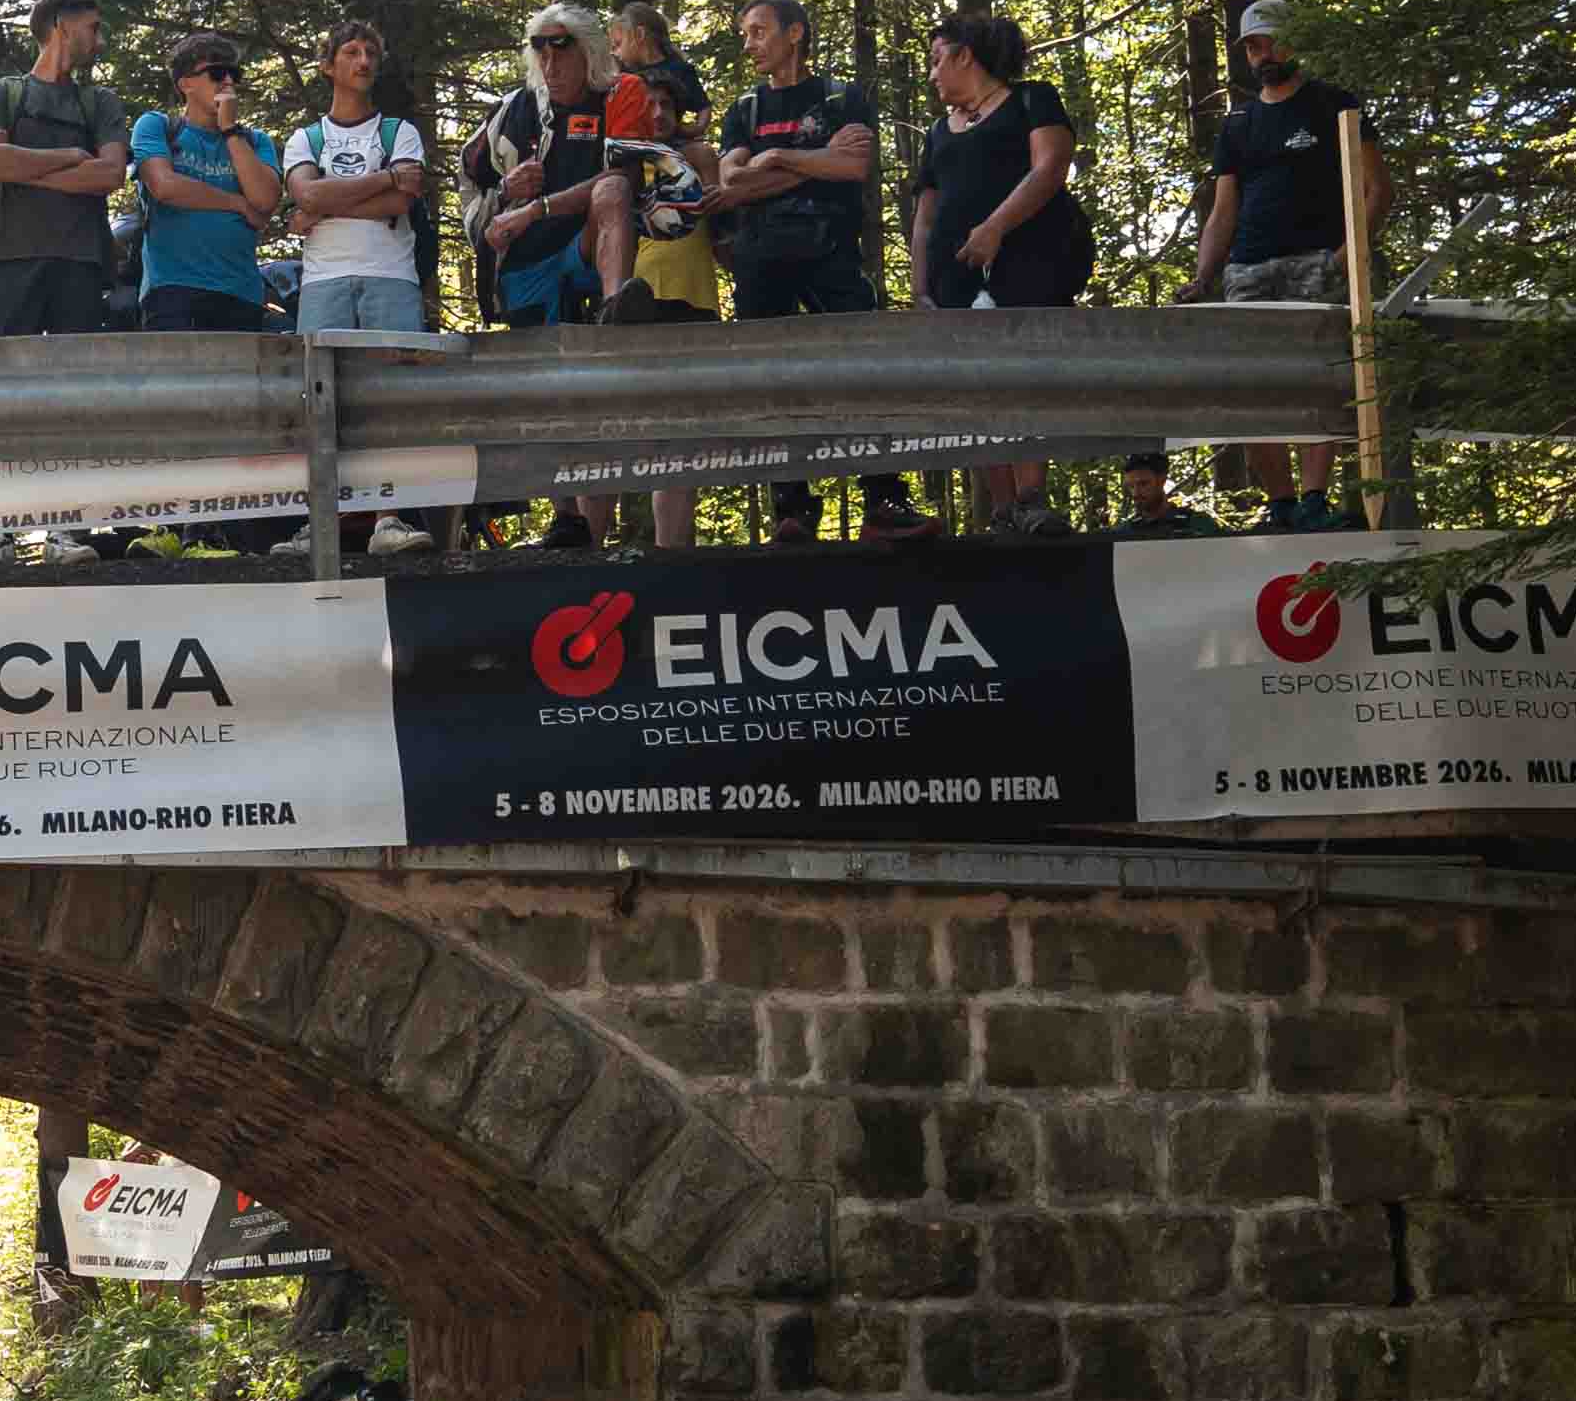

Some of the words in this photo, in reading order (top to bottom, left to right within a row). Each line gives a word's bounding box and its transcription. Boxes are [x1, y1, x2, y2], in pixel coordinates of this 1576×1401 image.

[653, 604, 999, 688] EICMA
[1260, 668, 1456, 694] ESPOSIZIONE
[538, 697, 743, 727] ESPOSIZIONE
[747, 682, 1005, 714] INTERNAZIONALE
[1354, 699, 1450, 723] DELLE
[1457, 698, 1512, 720] DUE
[642, 723, 738, 747] DELLE
[744, 720, 806, 743] DUE
[812, 716, 912, 739] RUOTE
[37, 757, 139, 778] RUOTE
[1214, 770, 1229, 794] 5
[1254, 769, 1271, 793] 8
[1280, 762, 1428, 792] NOVEMBRE
[1437, 759, 1512, 784] 2026.
[494, 794, 513, 818] 5
[538, 791, 557, 815] 8
[565, 785, 712, 816] NOVEMBRE
[721, 783, 802, 810] 2026.
[818, 777, 982, 807] MILANO-RHO
[990, 774, 1061, 802] FIERA
[41, 806, 212, 835] MILANO-RHO
[221, 800, 296, 828] FIERA
[108, 1185, 188, 1217] EICMA
